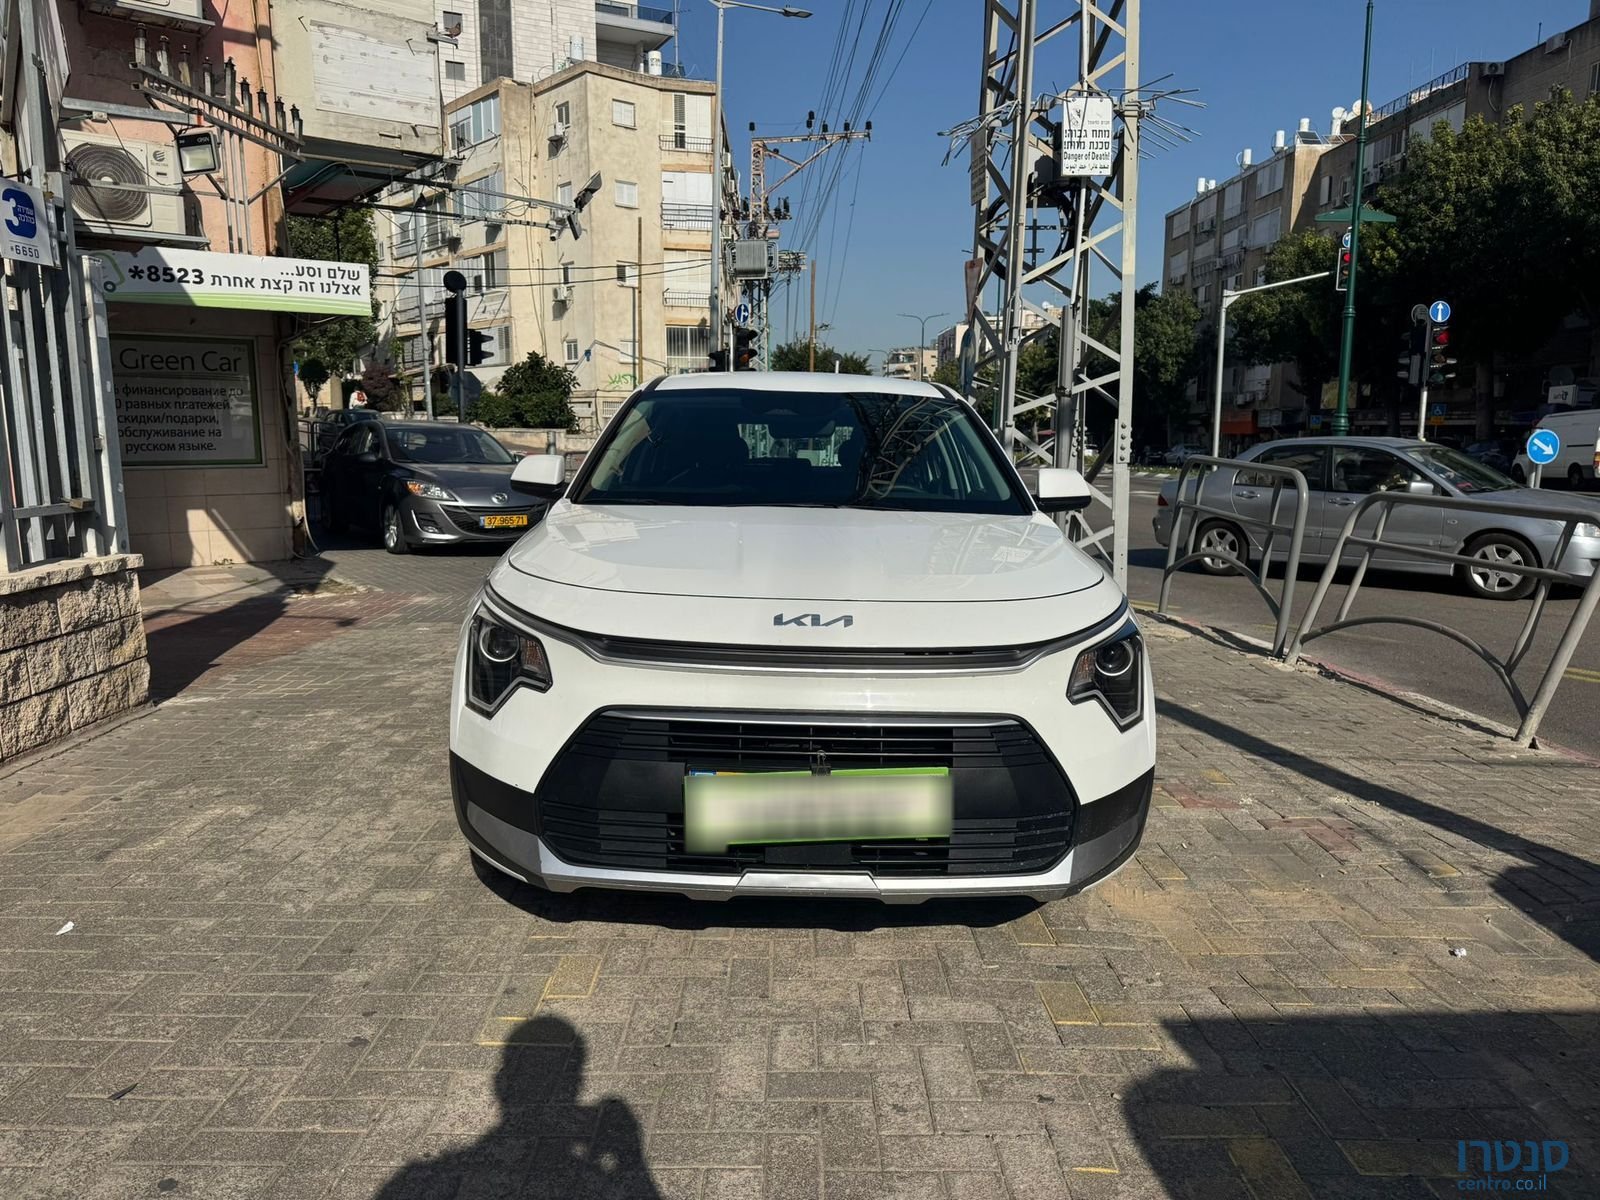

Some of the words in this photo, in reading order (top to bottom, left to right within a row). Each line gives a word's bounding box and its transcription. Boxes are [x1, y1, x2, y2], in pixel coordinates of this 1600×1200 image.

[1092, 129, 1110, 138] מתח
[1089, 141, 1110, 150] סכנת
[1064, 151, 1084, 162] Danger
[1084, 151, 1091, 161] of
[280, 265, 322, 278] וסע...
[327, 266, 361, 281] שלם
[211, 274, 255, 288] אחרת
[260, 277, 293, 294] קצת
[298, 281, 315, 293] זה
[320, 280, 361, 296] אצלנו
[119, 347, 195, 371] Green
[201, 350, 242, 372] Car
[122, 383, 227, 399] финансирование
[228, 389, 244, 399] до
[125, 400, 171, 411] равных
[117, 413, 219, 426] скидки/подарки,
[118, 426, 206, 439] обслуживание
[208, 428, 222, 438] на
[125, 442, 176, 454] русском
[178, 441, 217, 451] языке.
[773, 613, 854, 628] KIA
